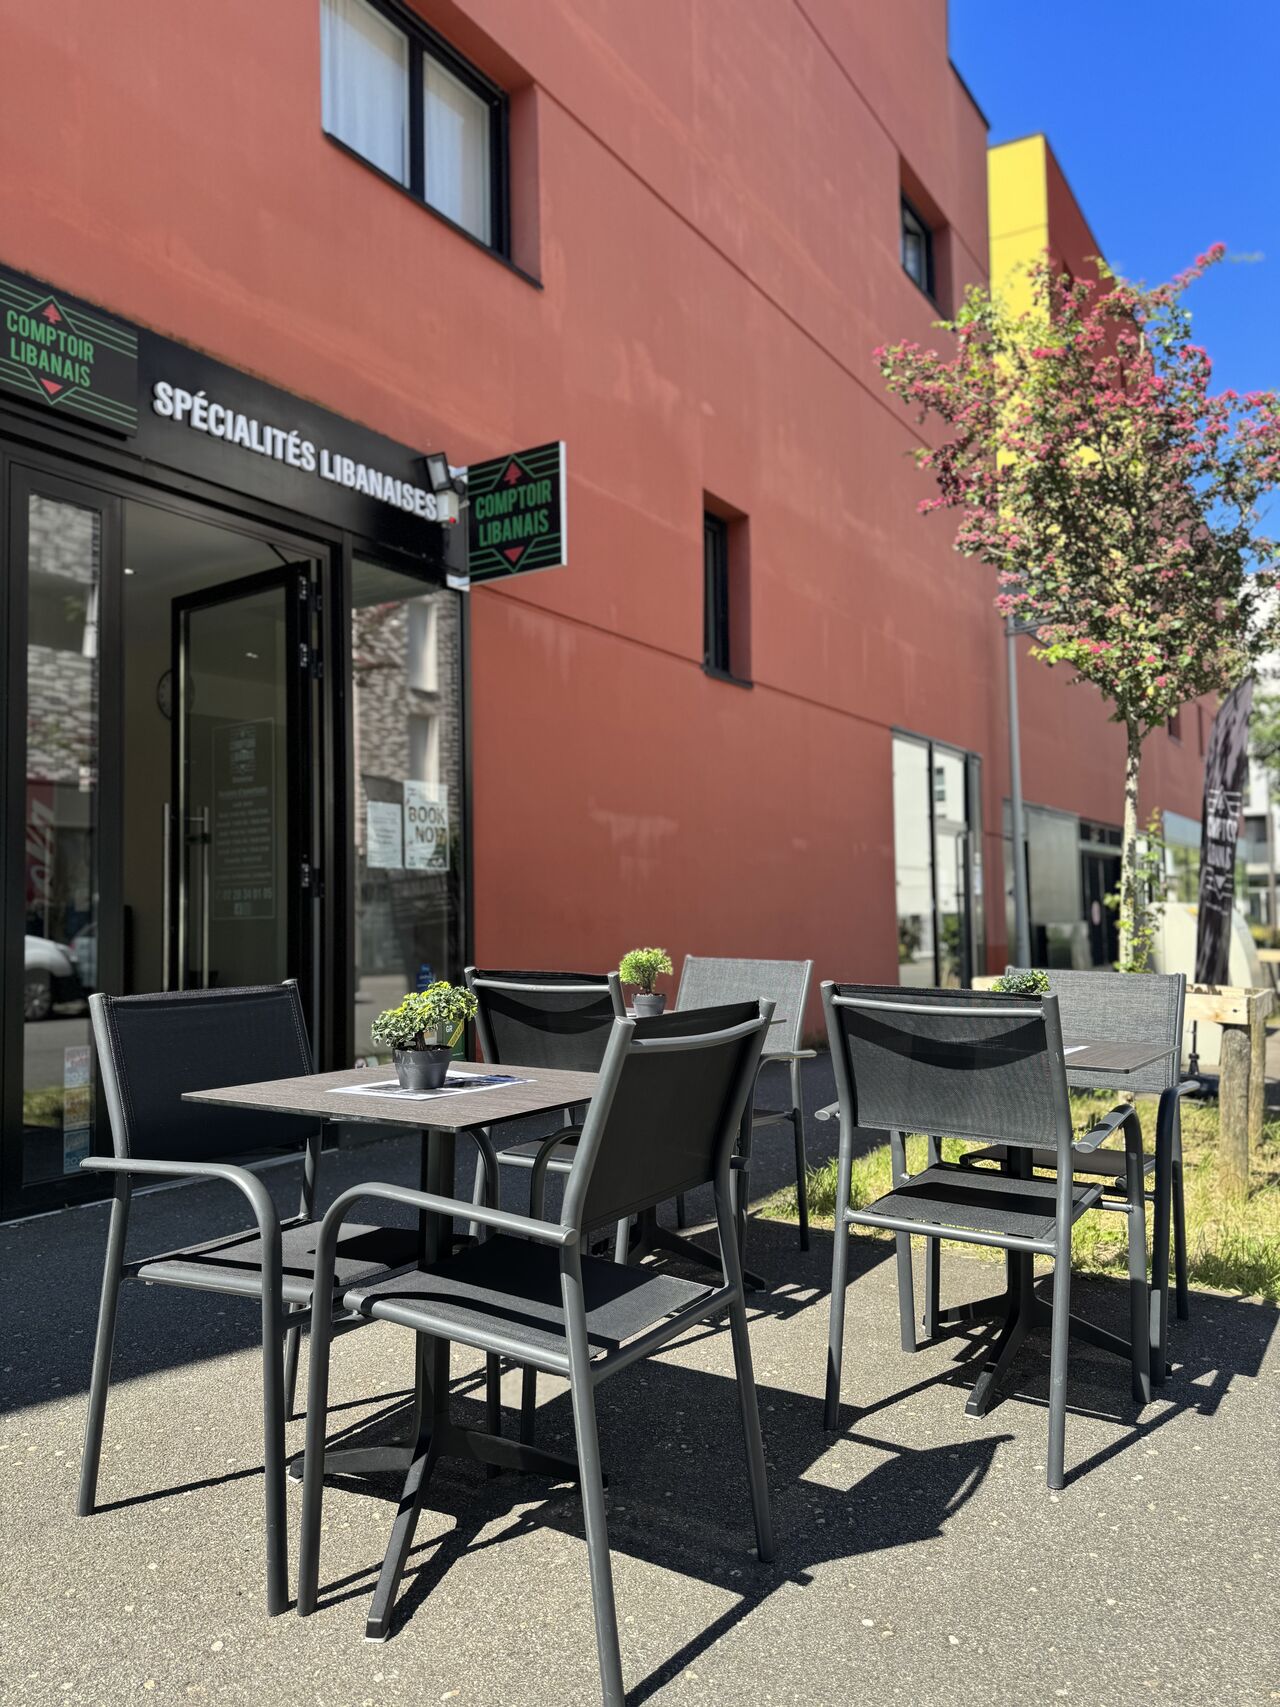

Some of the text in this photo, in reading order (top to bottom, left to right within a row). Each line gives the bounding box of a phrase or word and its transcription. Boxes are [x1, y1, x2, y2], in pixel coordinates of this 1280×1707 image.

[6, 309, 95, 364] COMPTOIR
[10, 337, 91, 388] LIBANAIS
[153, 381, 438, 522] SPÉCIALITÉS LIBANAISES
[475, 479, 552, 520] COMPTOIR
[478, 509, 550, 548] LIBANAIS
[408, 806, 446, 824] BOOK
